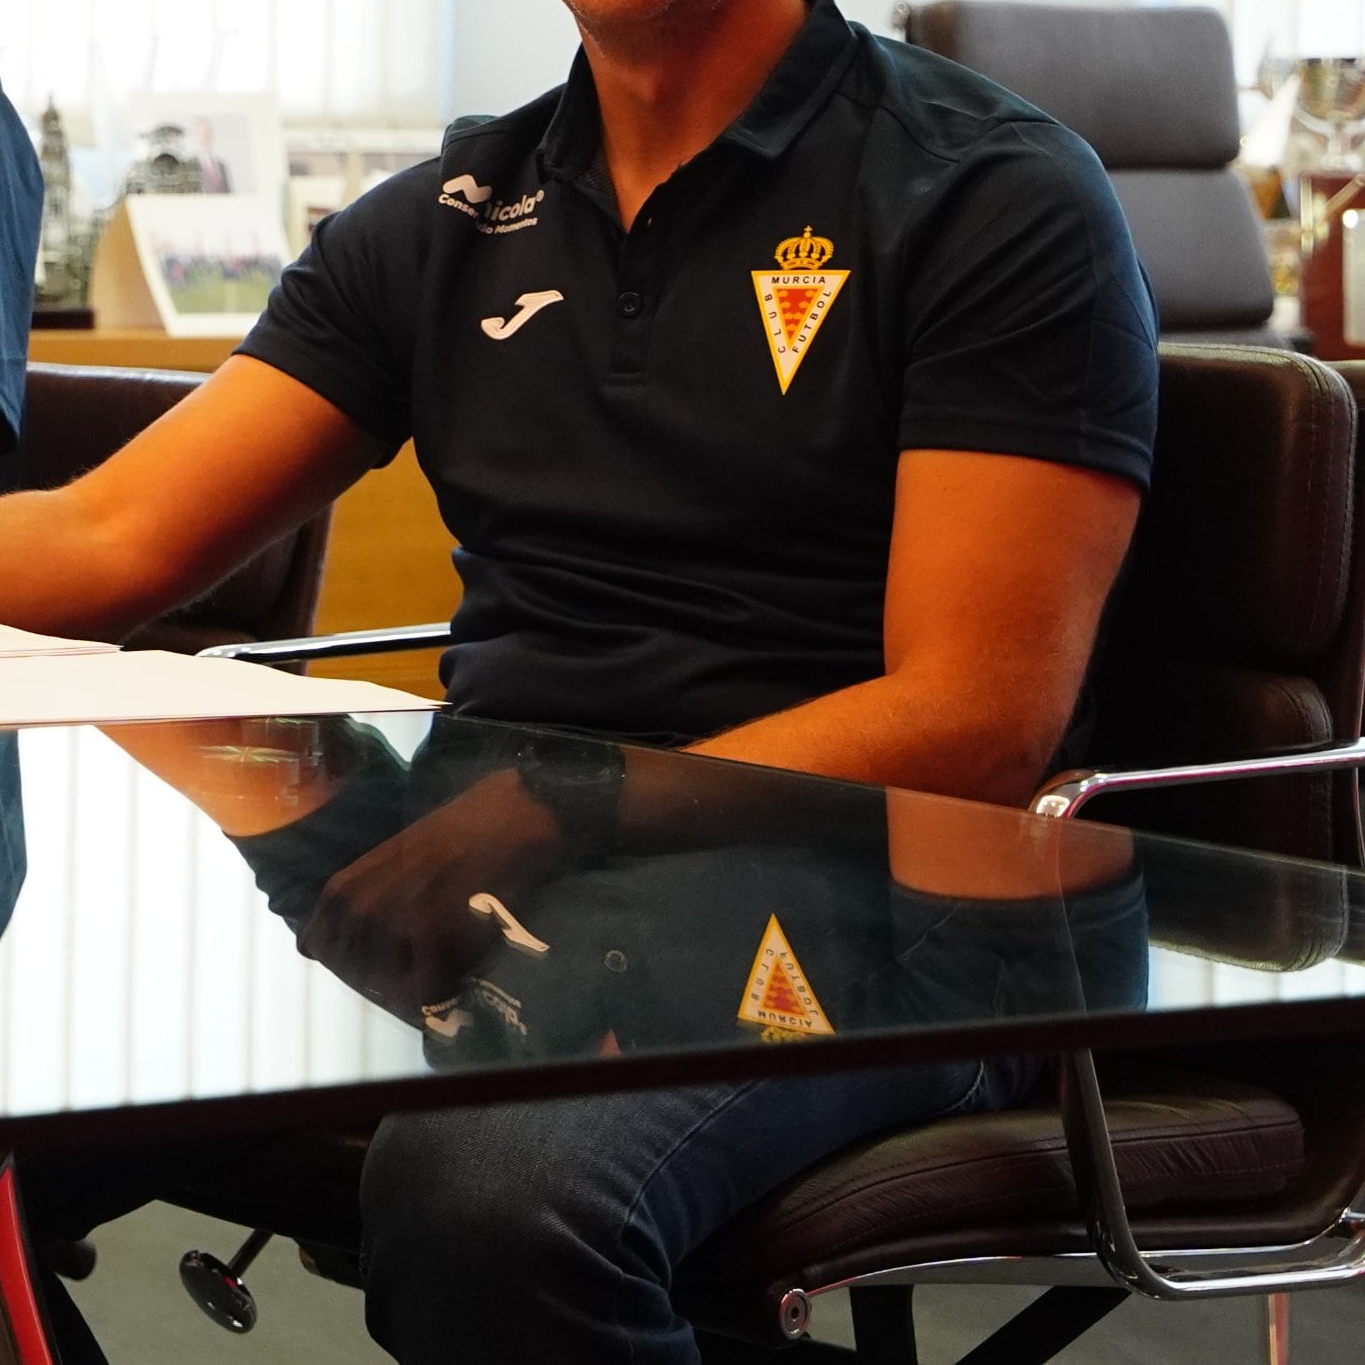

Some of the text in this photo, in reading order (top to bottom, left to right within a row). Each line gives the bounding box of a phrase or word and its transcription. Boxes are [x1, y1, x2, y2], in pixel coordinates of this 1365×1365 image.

[771, 276, 826, 284] MURCIA
[764, 293, 786, 354] CLUB
[792, 290, 831, 353] FUTBOL
